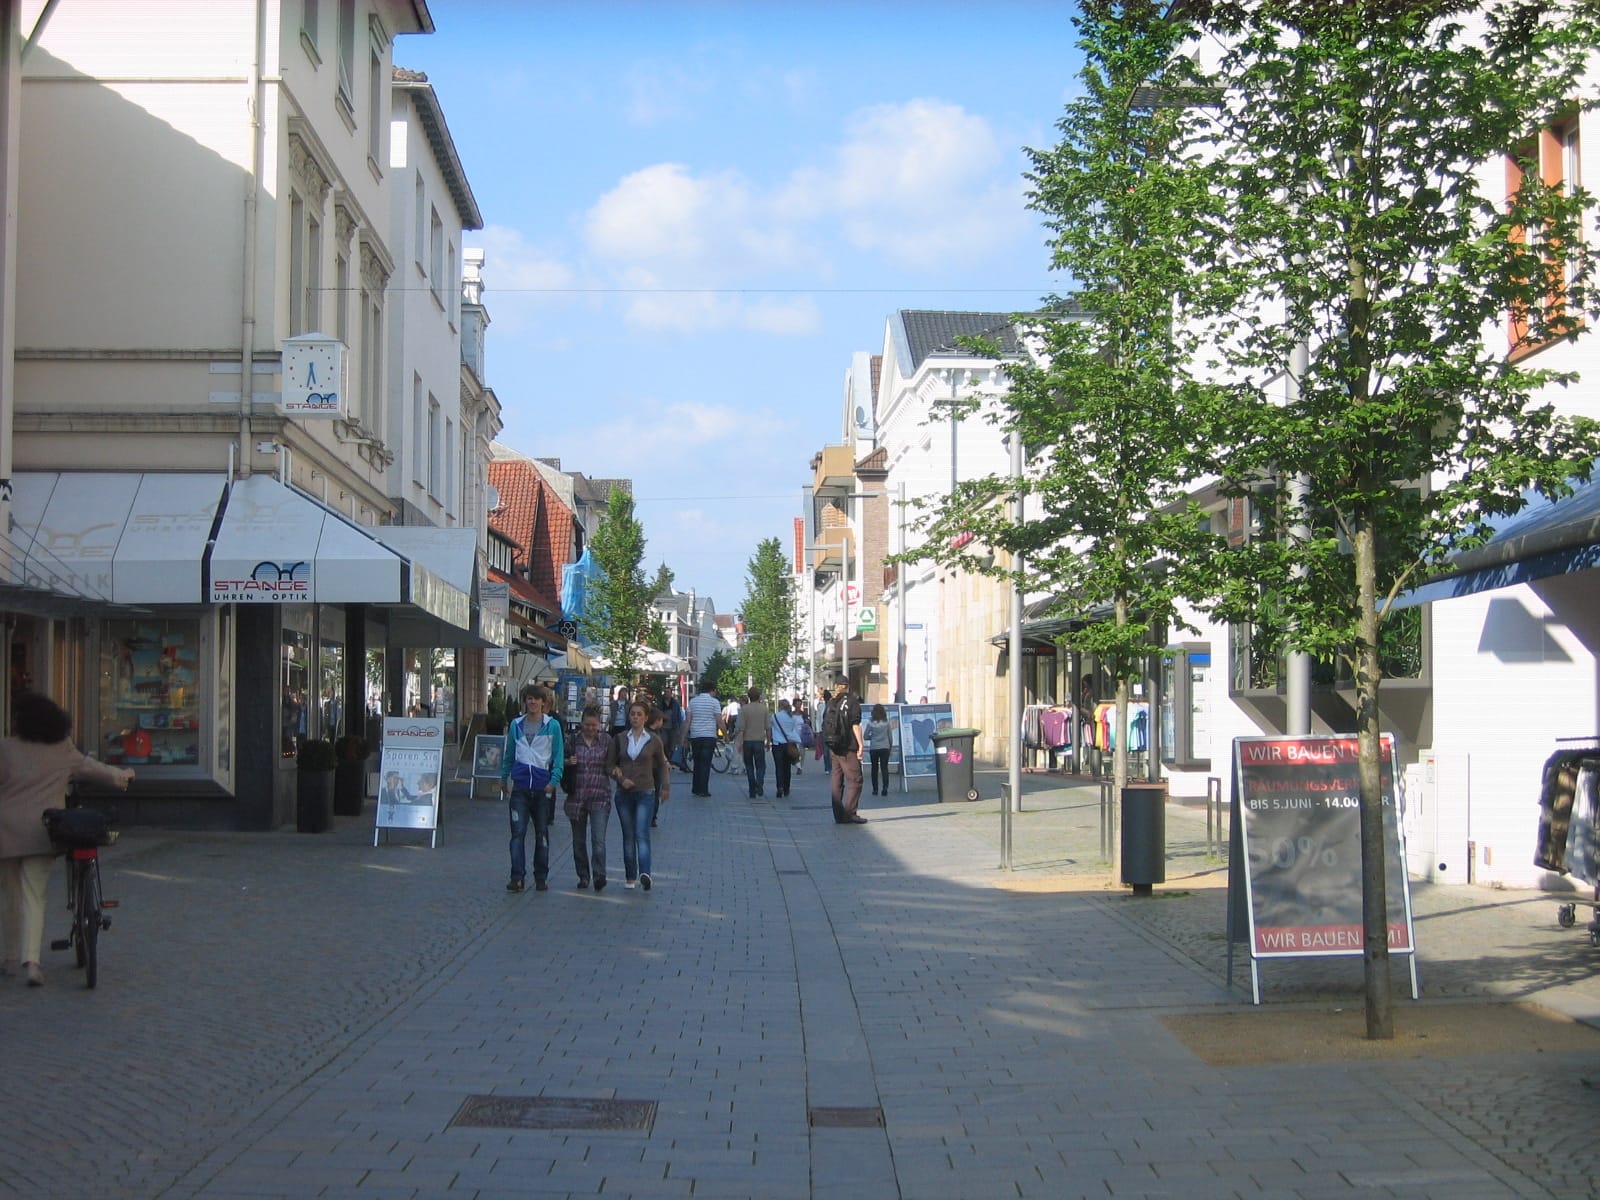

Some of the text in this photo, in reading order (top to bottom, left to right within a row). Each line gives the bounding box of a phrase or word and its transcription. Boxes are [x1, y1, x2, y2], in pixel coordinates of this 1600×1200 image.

[27, 573, 111, 589] OPTIK
[214, 581, 308, 591] STANGE
[214, 593, 254, 601] UHREN
[271, 593, 308, 601] OPTIK
[386, 730, 435, 738] STANGE
[1249, 743, 1386, 761] WIR BAUEN U!
[1250, 798, 1269, 810] BIS
[1272, 798, 1313, 810] 5.JUNI
[1324, 796, 1359, 809] 14.00
[1261, 933, 1296, 949] WIR
[1301, 930, 1361, 947] BAUEN
